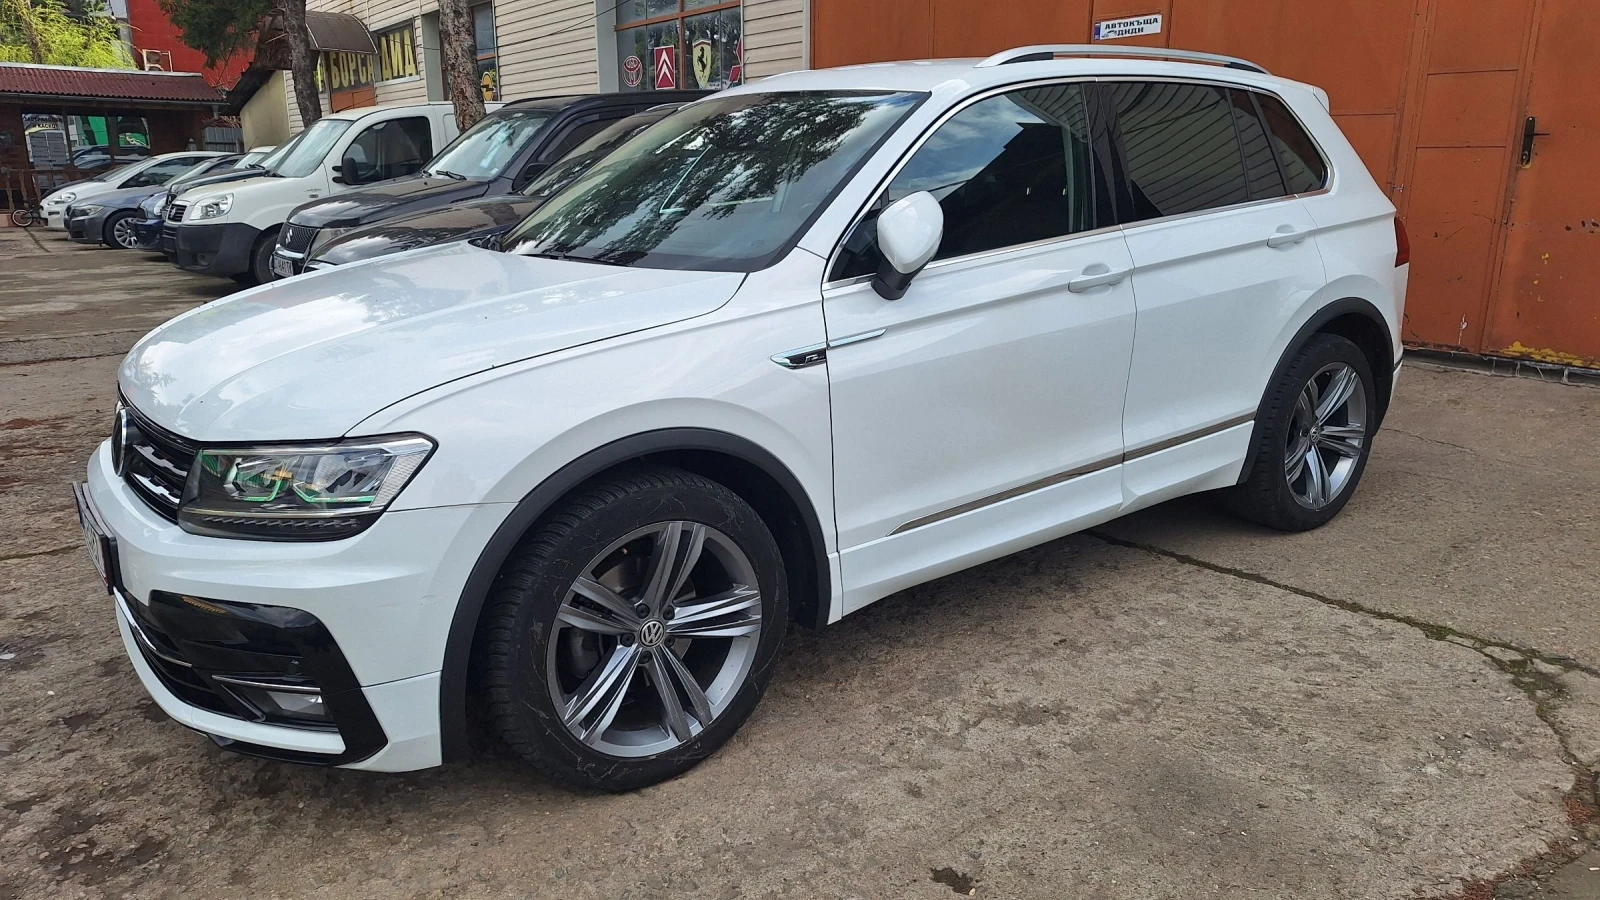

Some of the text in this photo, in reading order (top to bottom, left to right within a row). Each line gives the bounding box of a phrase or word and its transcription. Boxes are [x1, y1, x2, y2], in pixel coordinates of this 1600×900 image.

[1104, 17, 1159, 30] АВТОКЪЩА
[1116, 26, 1144, 36] ДИДИ
[330, 51, 374, 89] БОРСА
[642, 622, 663, 645] VW
